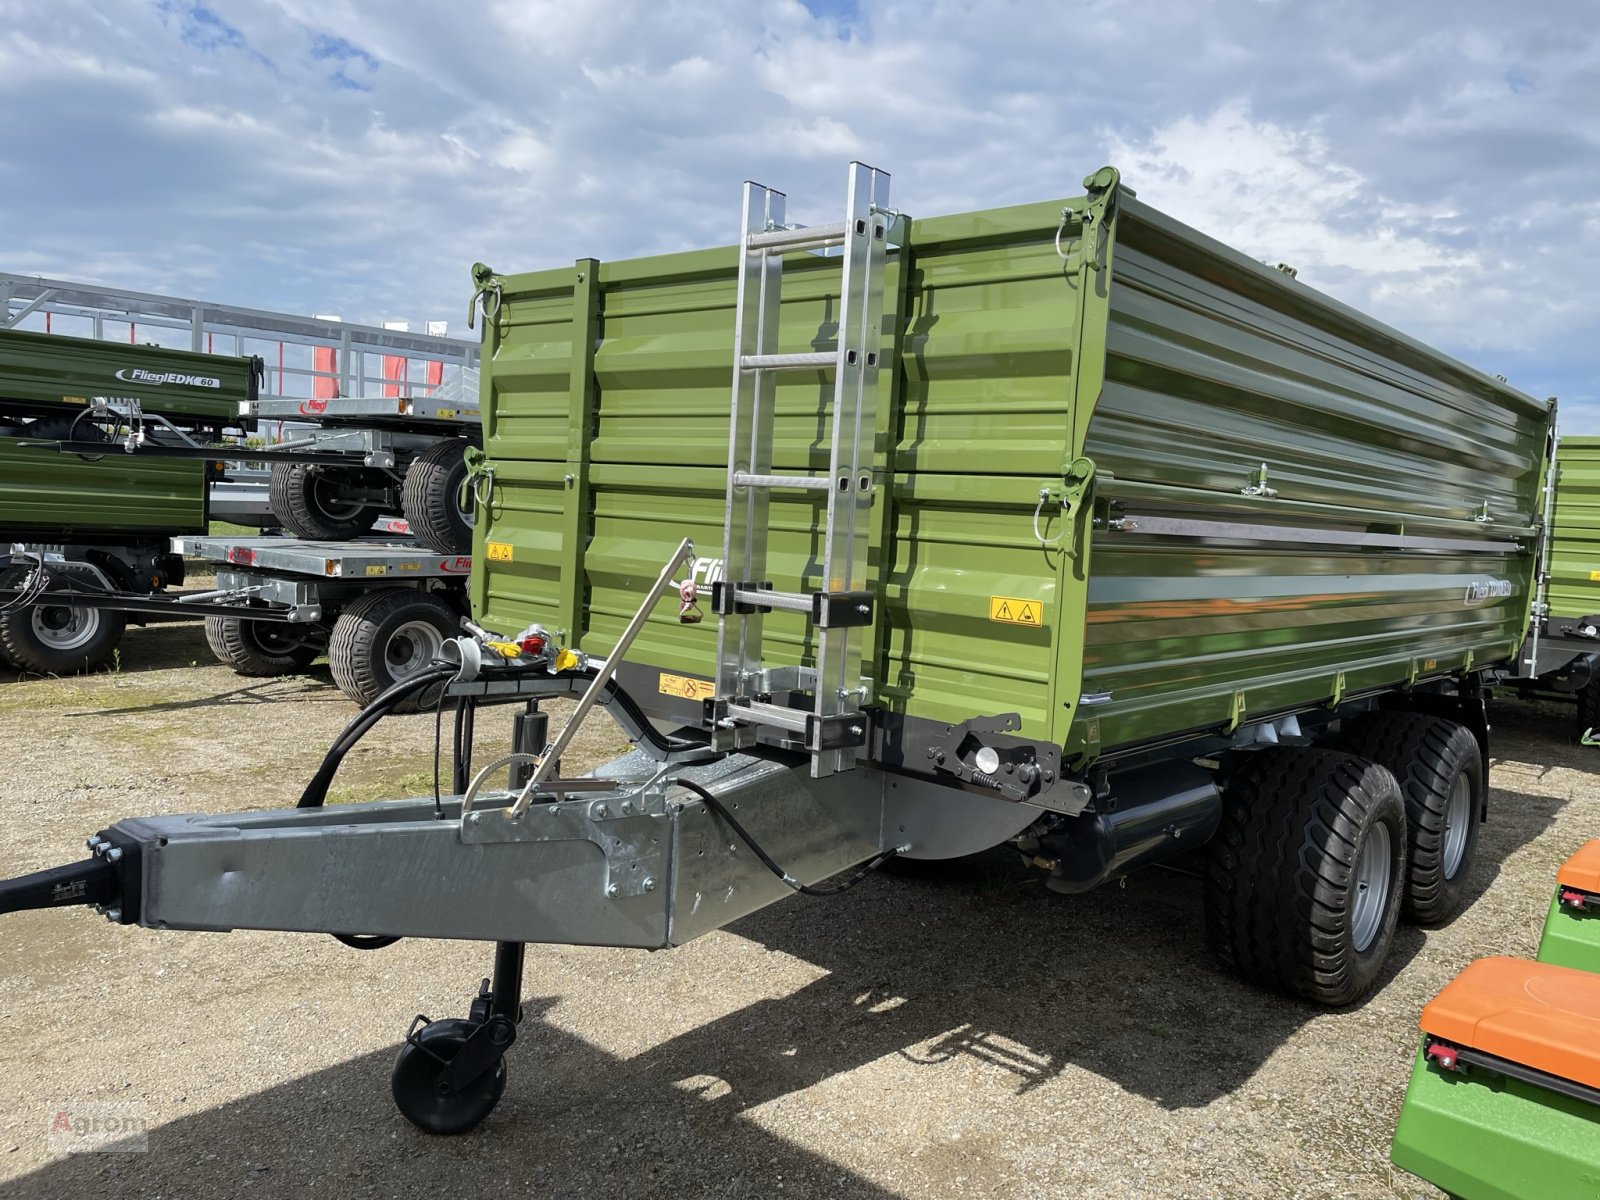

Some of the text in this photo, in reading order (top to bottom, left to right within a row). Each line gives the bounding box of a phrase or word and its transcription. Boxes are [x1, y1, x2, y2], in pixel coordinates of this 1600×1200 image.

[200, 378, 214, 387] 60
[455, 557, 472, 568] Fli
[691, 557, 723, 585] Fli
